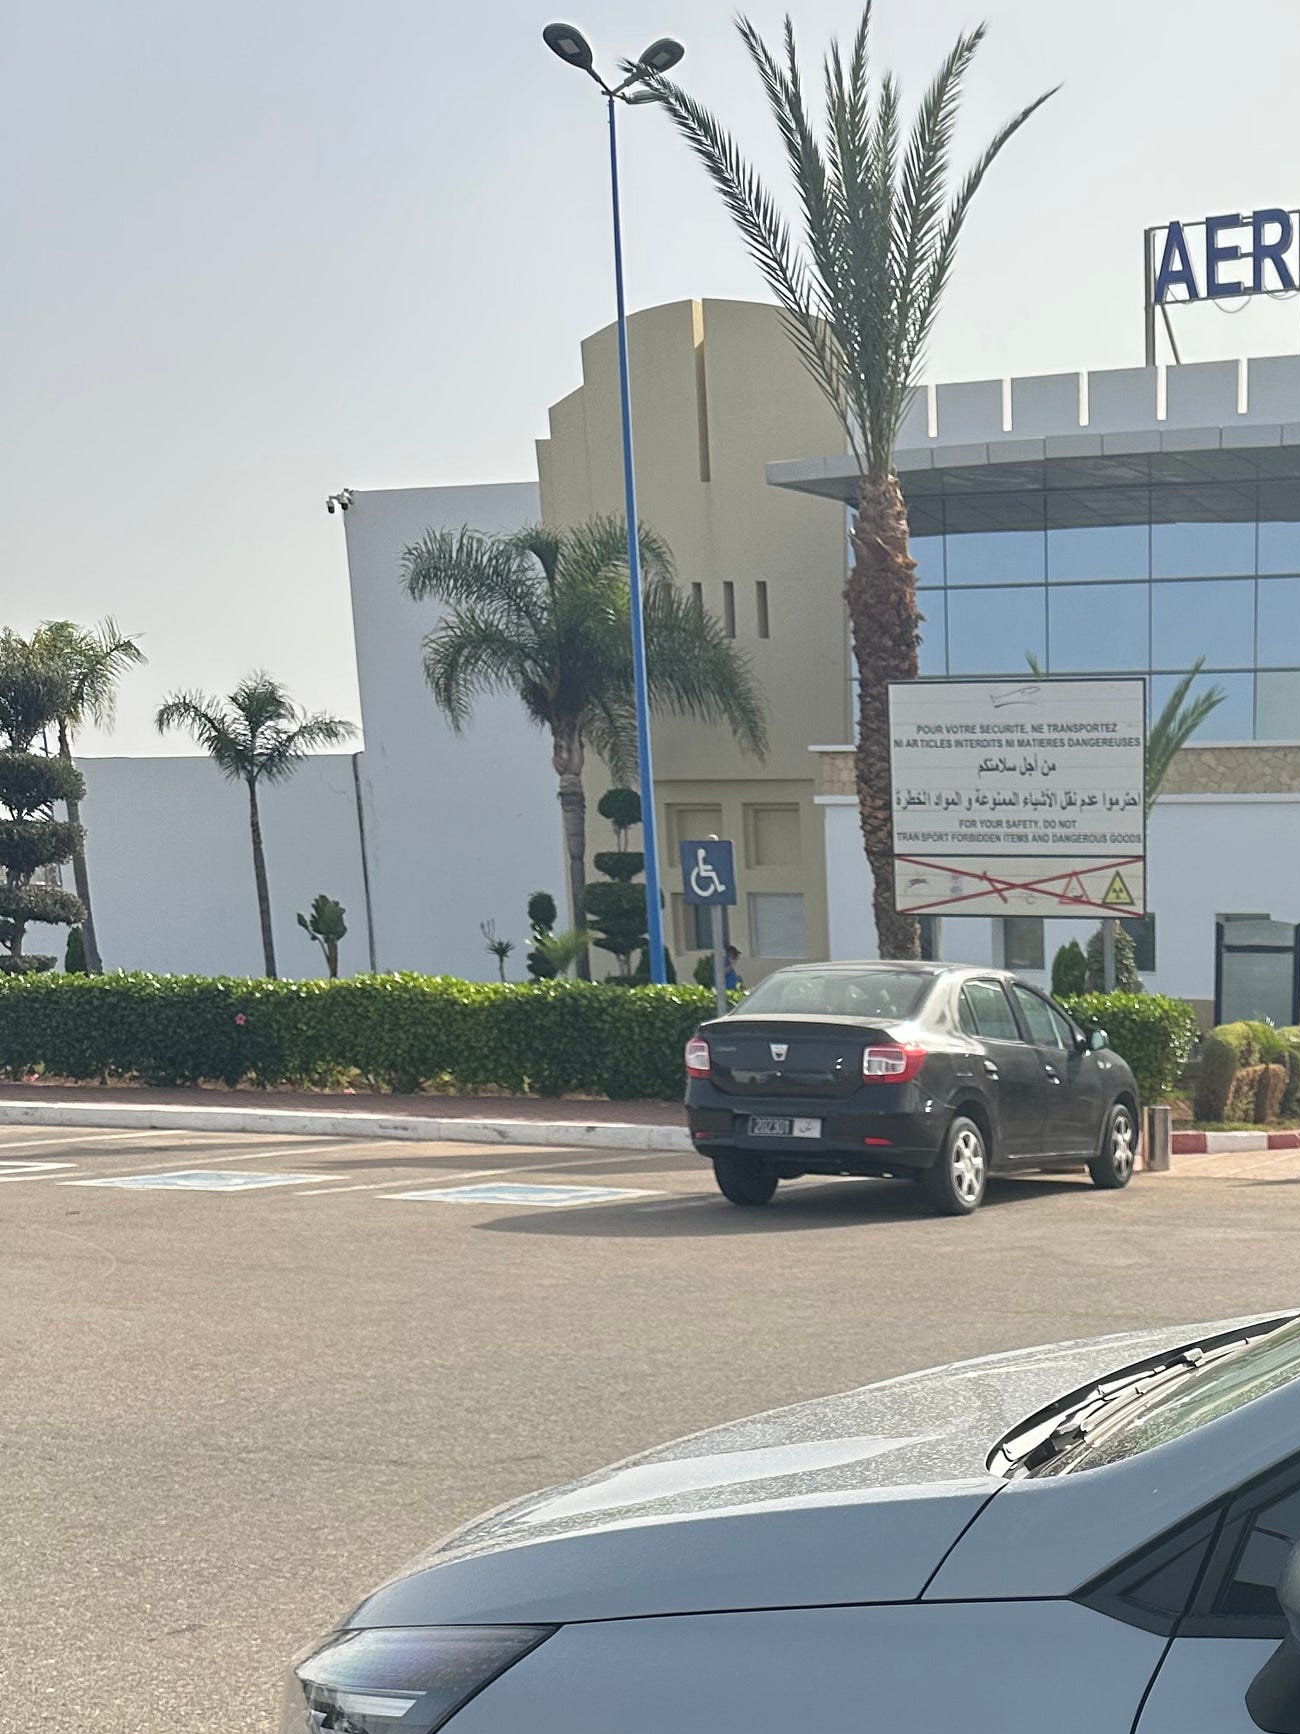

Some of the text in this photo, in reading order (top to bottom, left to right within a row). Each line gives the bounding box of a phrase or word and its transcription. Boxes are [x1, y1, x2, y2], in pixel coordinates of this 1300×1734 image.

[916, 725, 944, 735] POUR
[945, 725, 977, 734] VOTRE
[1031, 724, 1044, 733] NE
[1047, 723, 1118, 733] TRANSPORTEZ
[894, 737, 1141, 748] NI ARTICLES INTERDITS NI MATIERES DANGEREUSES
[978, 757, 1016, 779] سلامتكم
[1041, 760, 1056, 776] من
[896, 789, 931, 810] الخطرة
[934, 791, 962, 811] المواد
[965, 797, 972, 811] و
[975, 788, 1019, 811] الممنوعة
[1060, 791, 1077, 810] نقل
[1080, 794, 1098, 812] عدم
[1103, 791, 1141, 811] احترموا
[959, 819, 977, 829] FOR
[980, 819, 1004, 829] YOUR
[1043, 819, 1056, 829] DO
[1058, 819, 1077, 829] NOT
[951, 833, 1001, 843] FORBIDDEN
[1003, 833, 1029, 843] ITEMS
[1032, 834, 1049, 843] AND
[1051, 834, 1108, 843] DANGEROUS
[1109, 834, 1141, 843] GOODS
